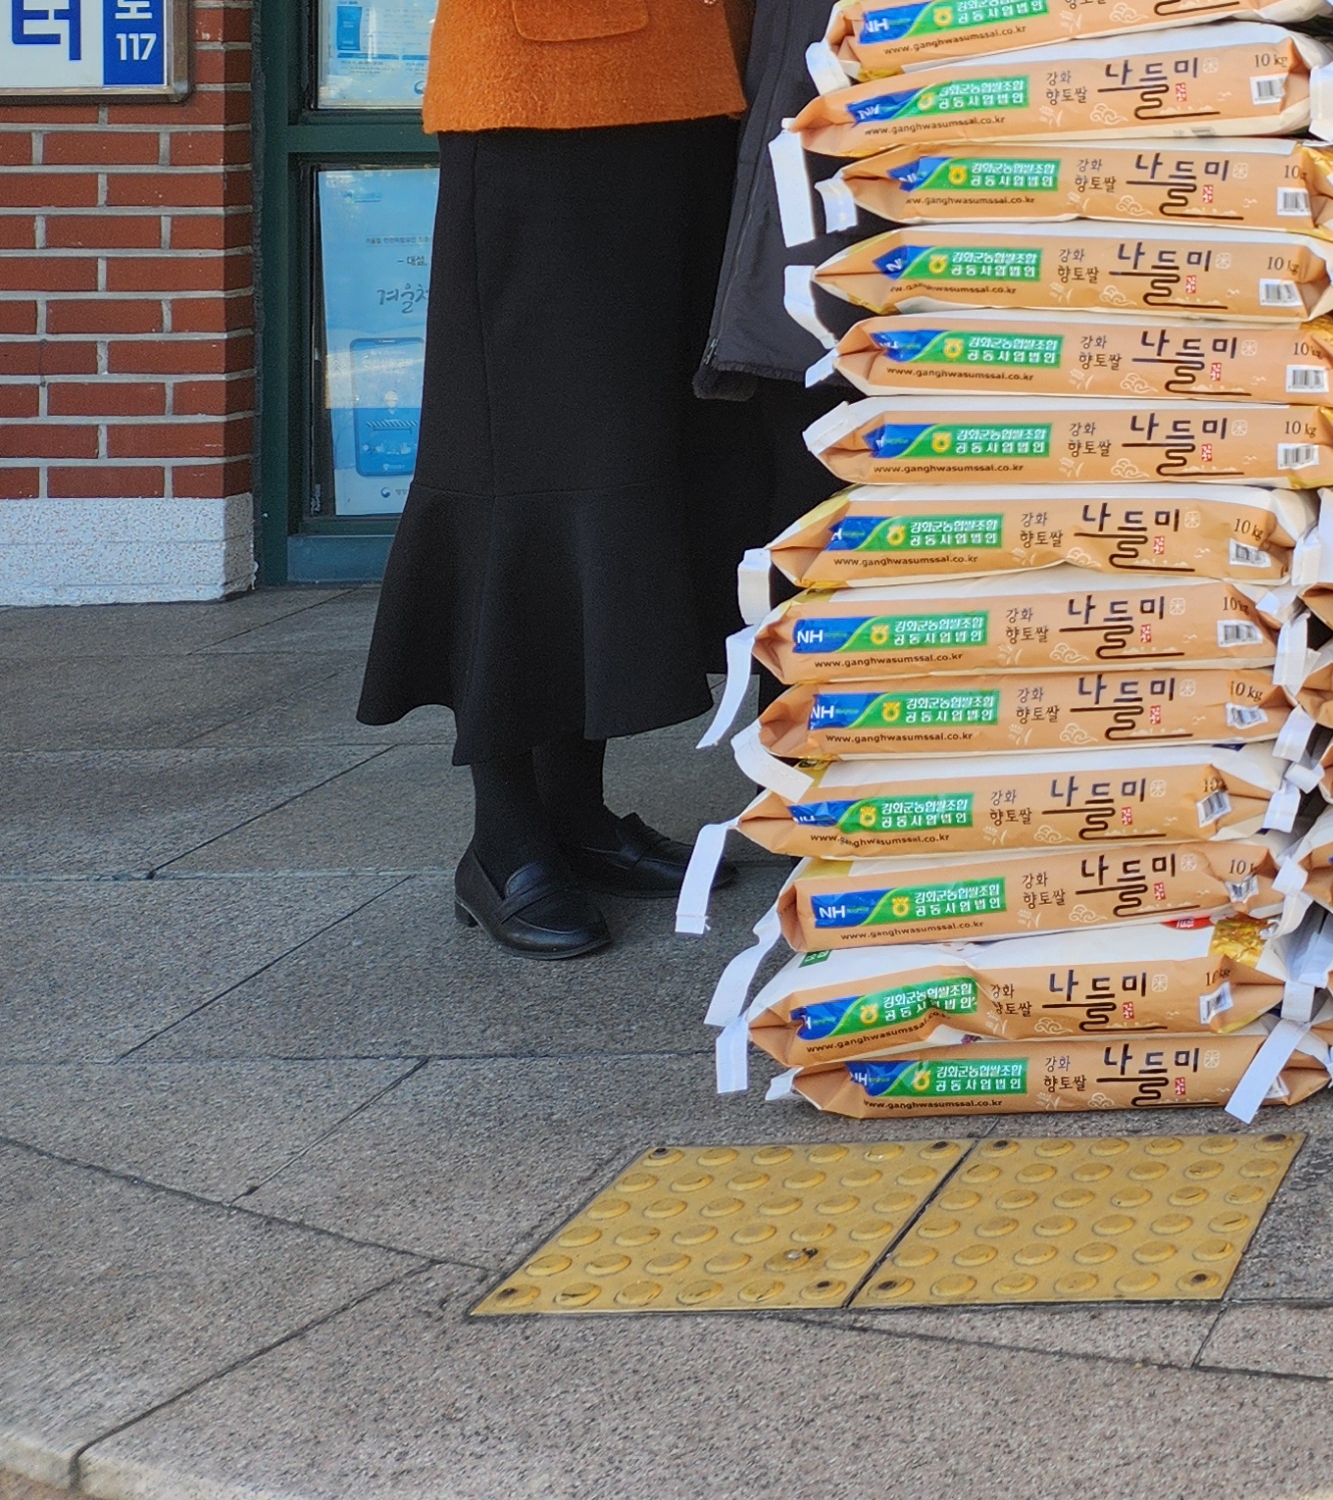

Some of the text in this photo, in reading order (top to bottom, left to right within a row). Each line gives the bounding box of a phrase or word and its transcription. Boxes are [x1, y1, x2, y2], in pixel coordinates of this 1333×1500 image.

[115, 33, 157, 60] 117
[1070, 422, 1096, 436] 강화
[956, 440, 1046, 454] 공동사업법인
[1068, 440, 1111, 457] 향토쌀
[873, 463, 1024, 475] www.ganghwasumssal.co.kr
[1223, 597, 1237, 611] 10
[1006, 608, 1032, 623] 강화
[797, 629, 823, 643] NH
[895, 628, 982, 646] 공동사업법인
[1005, 626, 1048, 644] 향토쌀
[814, 653, 963, 668] www.ganghwasumssal.co.kr
